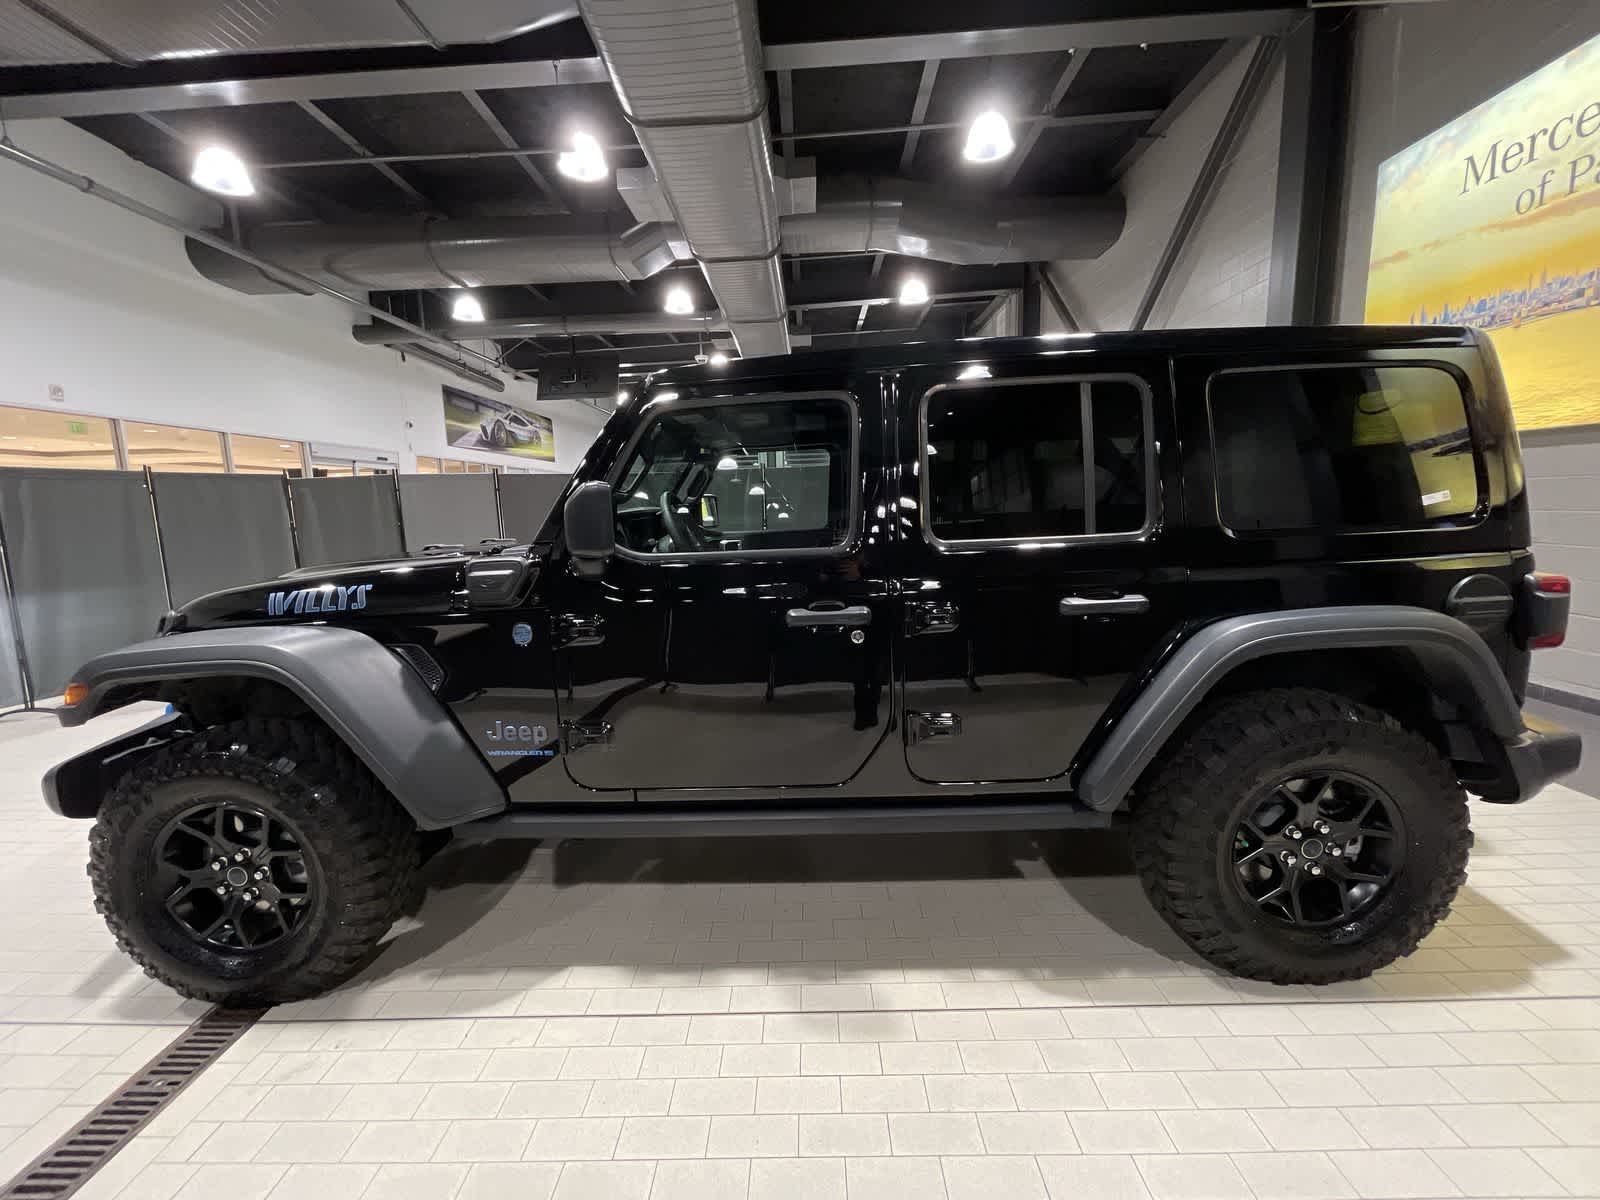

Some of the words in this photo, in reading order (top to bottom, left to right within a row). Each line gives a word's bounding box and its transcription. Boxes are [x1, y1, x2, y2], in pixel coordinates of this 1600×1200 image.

[1459, 101, 1600, 196] Merce
[1515, 169, 1555, 215] of
[1567, 154, 1600, 196] P
[268, 584, 373, 616] WILLYS
[486, 720, 548, 745] Jeep
